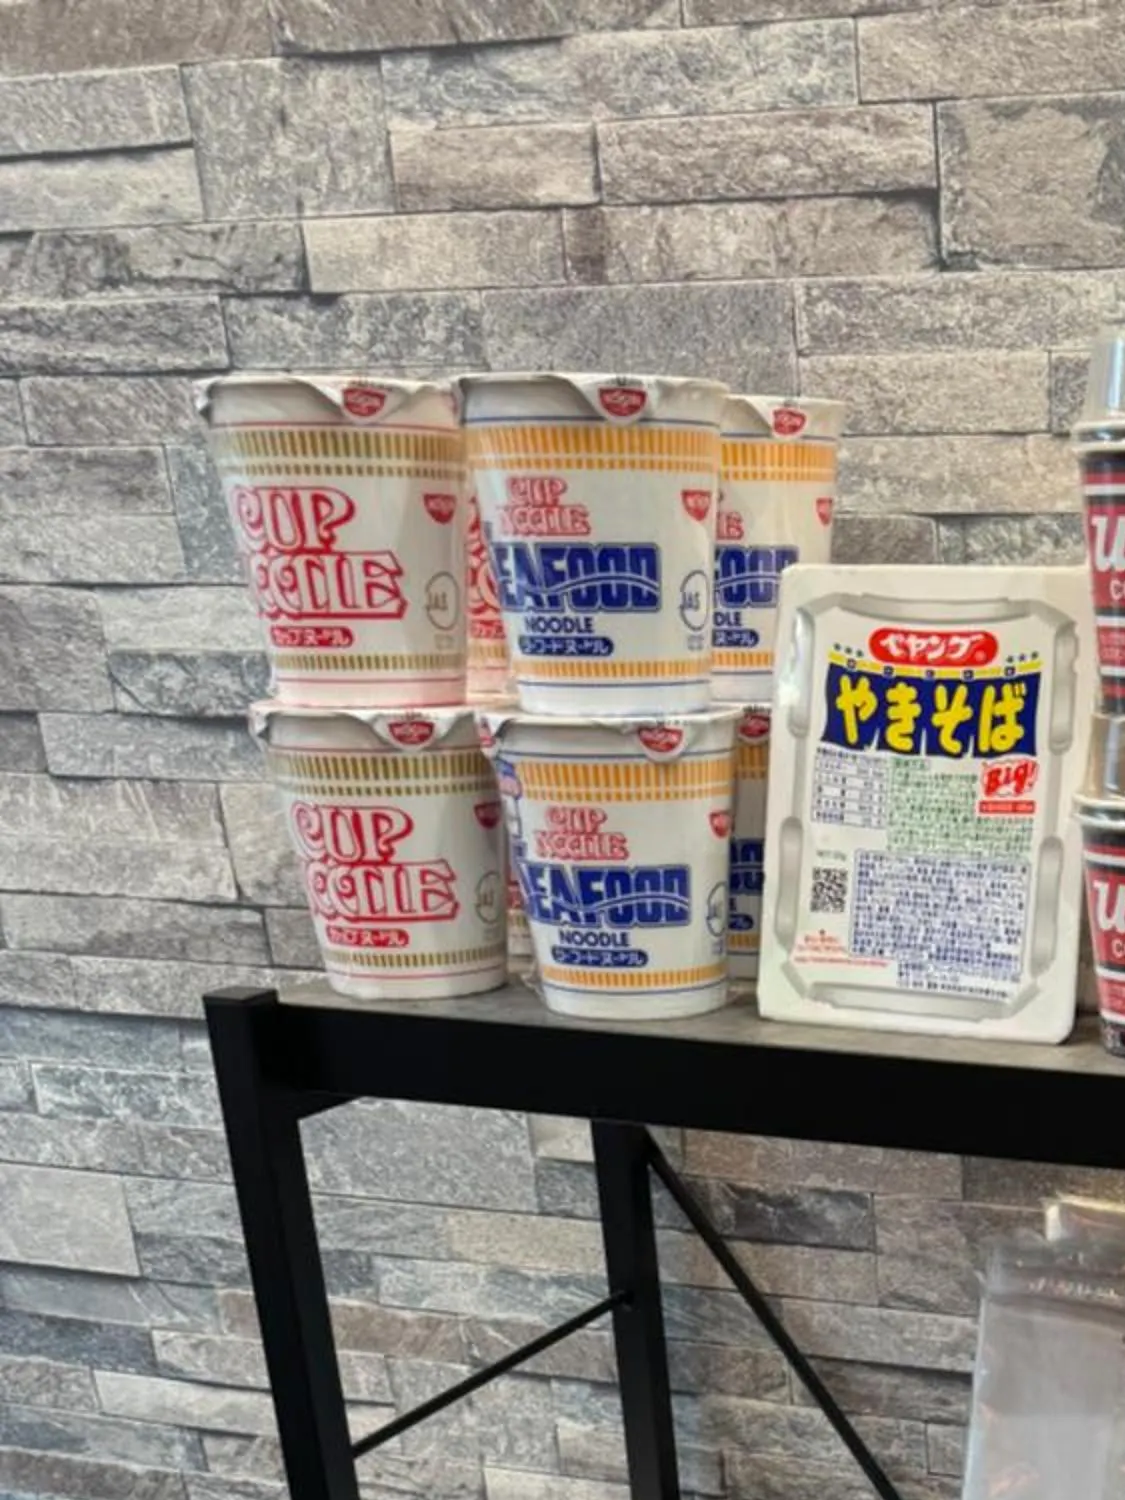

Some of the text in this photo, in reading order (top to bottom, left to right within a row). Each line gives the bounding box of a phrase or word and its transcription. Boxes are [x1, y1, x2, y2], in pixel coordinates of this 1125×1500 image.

[489, 542, 662, 613] EAFOOD
[525, 616, 594, 633] NOODLE
[880, 633, 986, 662] ペヤング
[835, 674, 1027, 755] やきそば
[521, 864, 692, 930] EAFOOD
[559, 930, 630, 947] NOODLE
